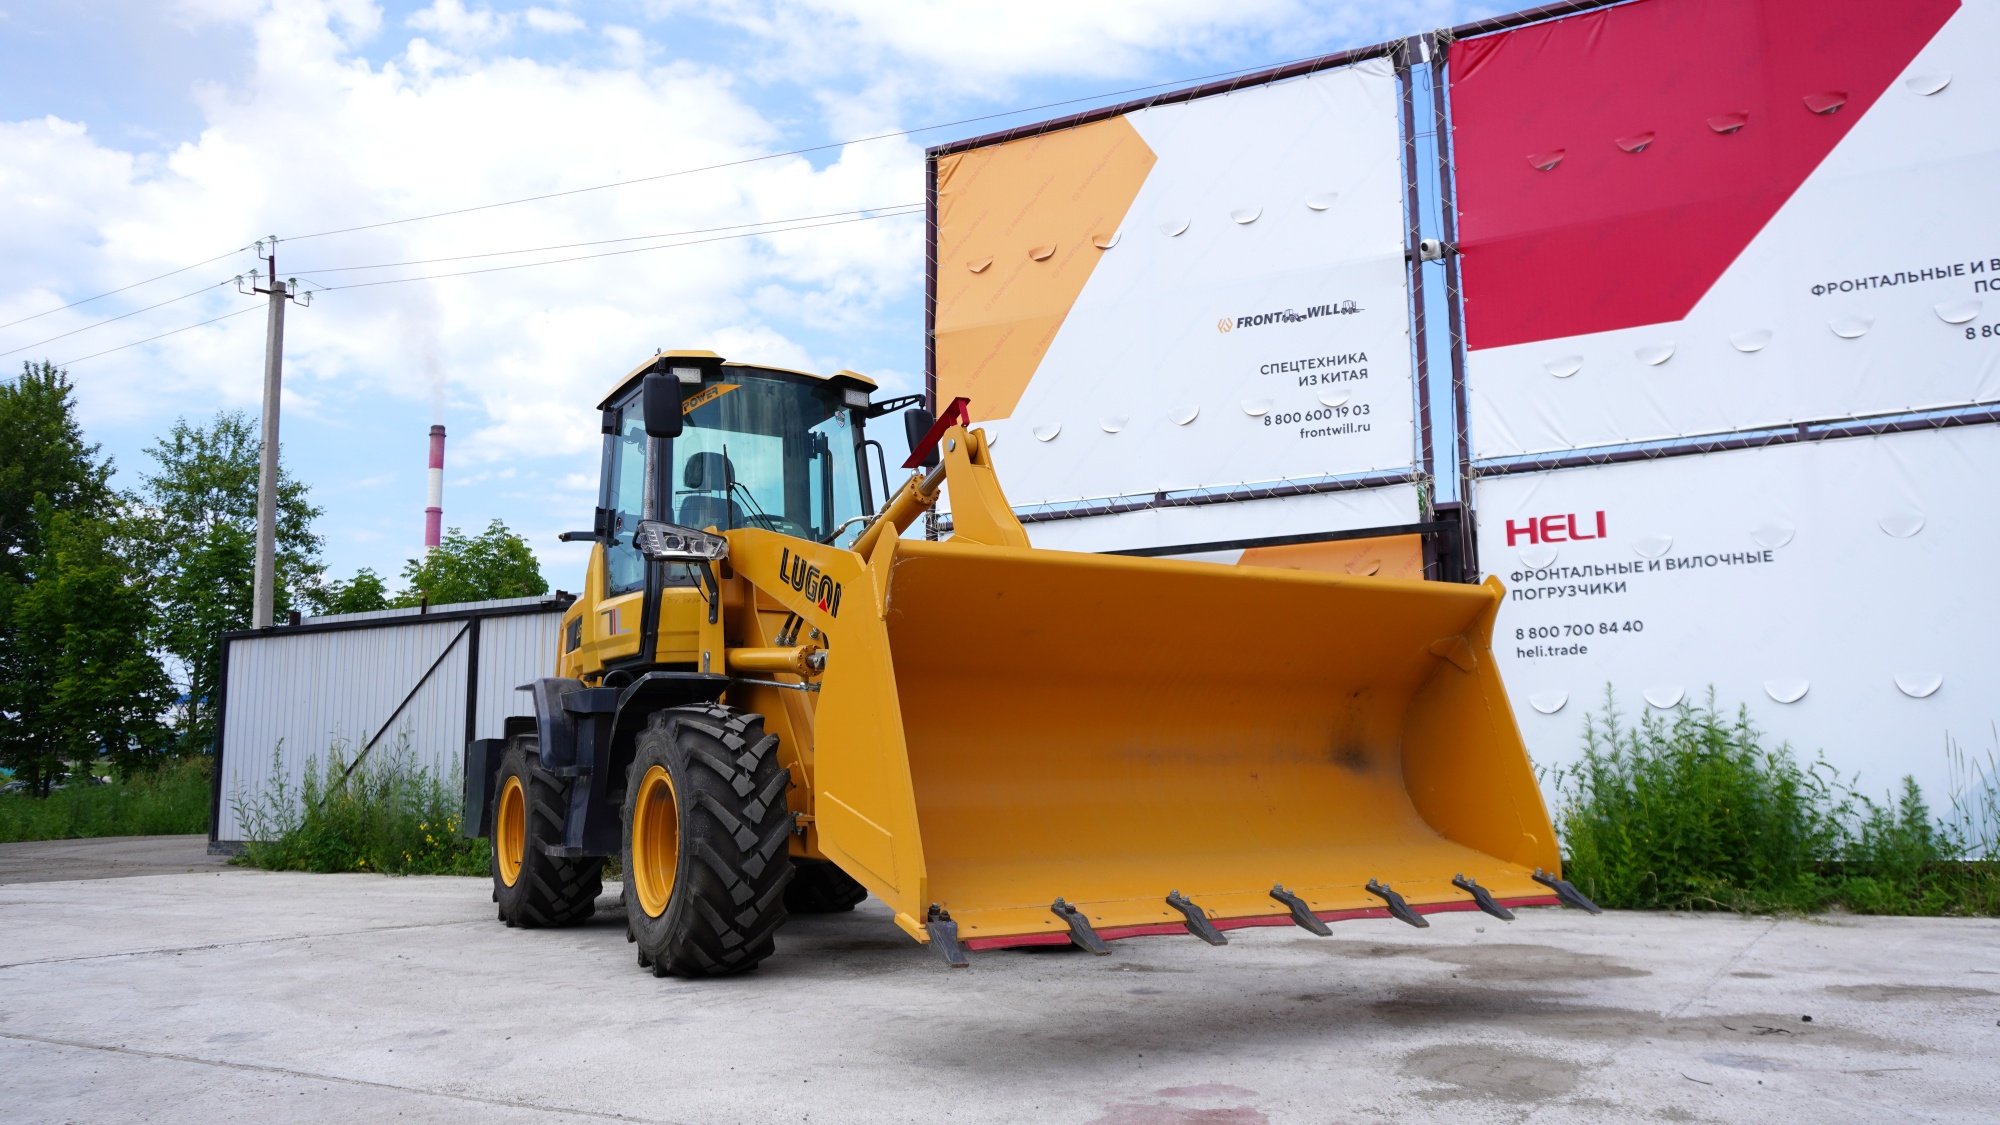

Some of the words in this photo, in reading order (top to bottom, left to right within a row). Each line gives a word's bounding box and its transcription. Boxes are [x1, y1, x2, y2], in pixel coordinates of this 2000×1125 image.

[1810, 263, 1966, 297] ФРОНТАЛЬНЫЕ
[1970, 260, 1985, 274] И
[1236, 311, 1283, 329] FRONT
[1307, 303, 1341, 318] WILL
[1965, 327, 1976, 340] 8
[1260, 351, 1368, 375] СПЕЦТЕХНИКА
[1299, 375, 1318, 387] ИЗ
[1321, 368, 1368, 385] КИТАЯ
[682, 387, 719, 412] POWER
[1264, 415, 1272, 426] 8
[1275, 412, 1302, 425] 800
[1305, 408, 1332, 422] 600
[1335, 406, 1349, 418] 19
[1352, 404, 1370, 415] 03
[1299, 422, 1371, 439] frontwill.ru
[1506, 510, 1607, 547] HELI
[1510, 560, 1644, 583] ФРОНТАЛЬНЫЕ
[1649, 559, 1661, 572] И
[1666, 549, 1774, 571] ВИЛОЧНЫЕ
[1512, 580, 1627, 601] ПОГРУЗЧИКИ
[1515, 628, 1525, 640] 8
[1528, 625, 1560, 640] 800
[1563, 623, 1595, 637] 700
[1599, 621, 1619, 635] 84
[1622, 619, 1644, 633] 40
[1516, 643, 1588, 659] heli.trade
